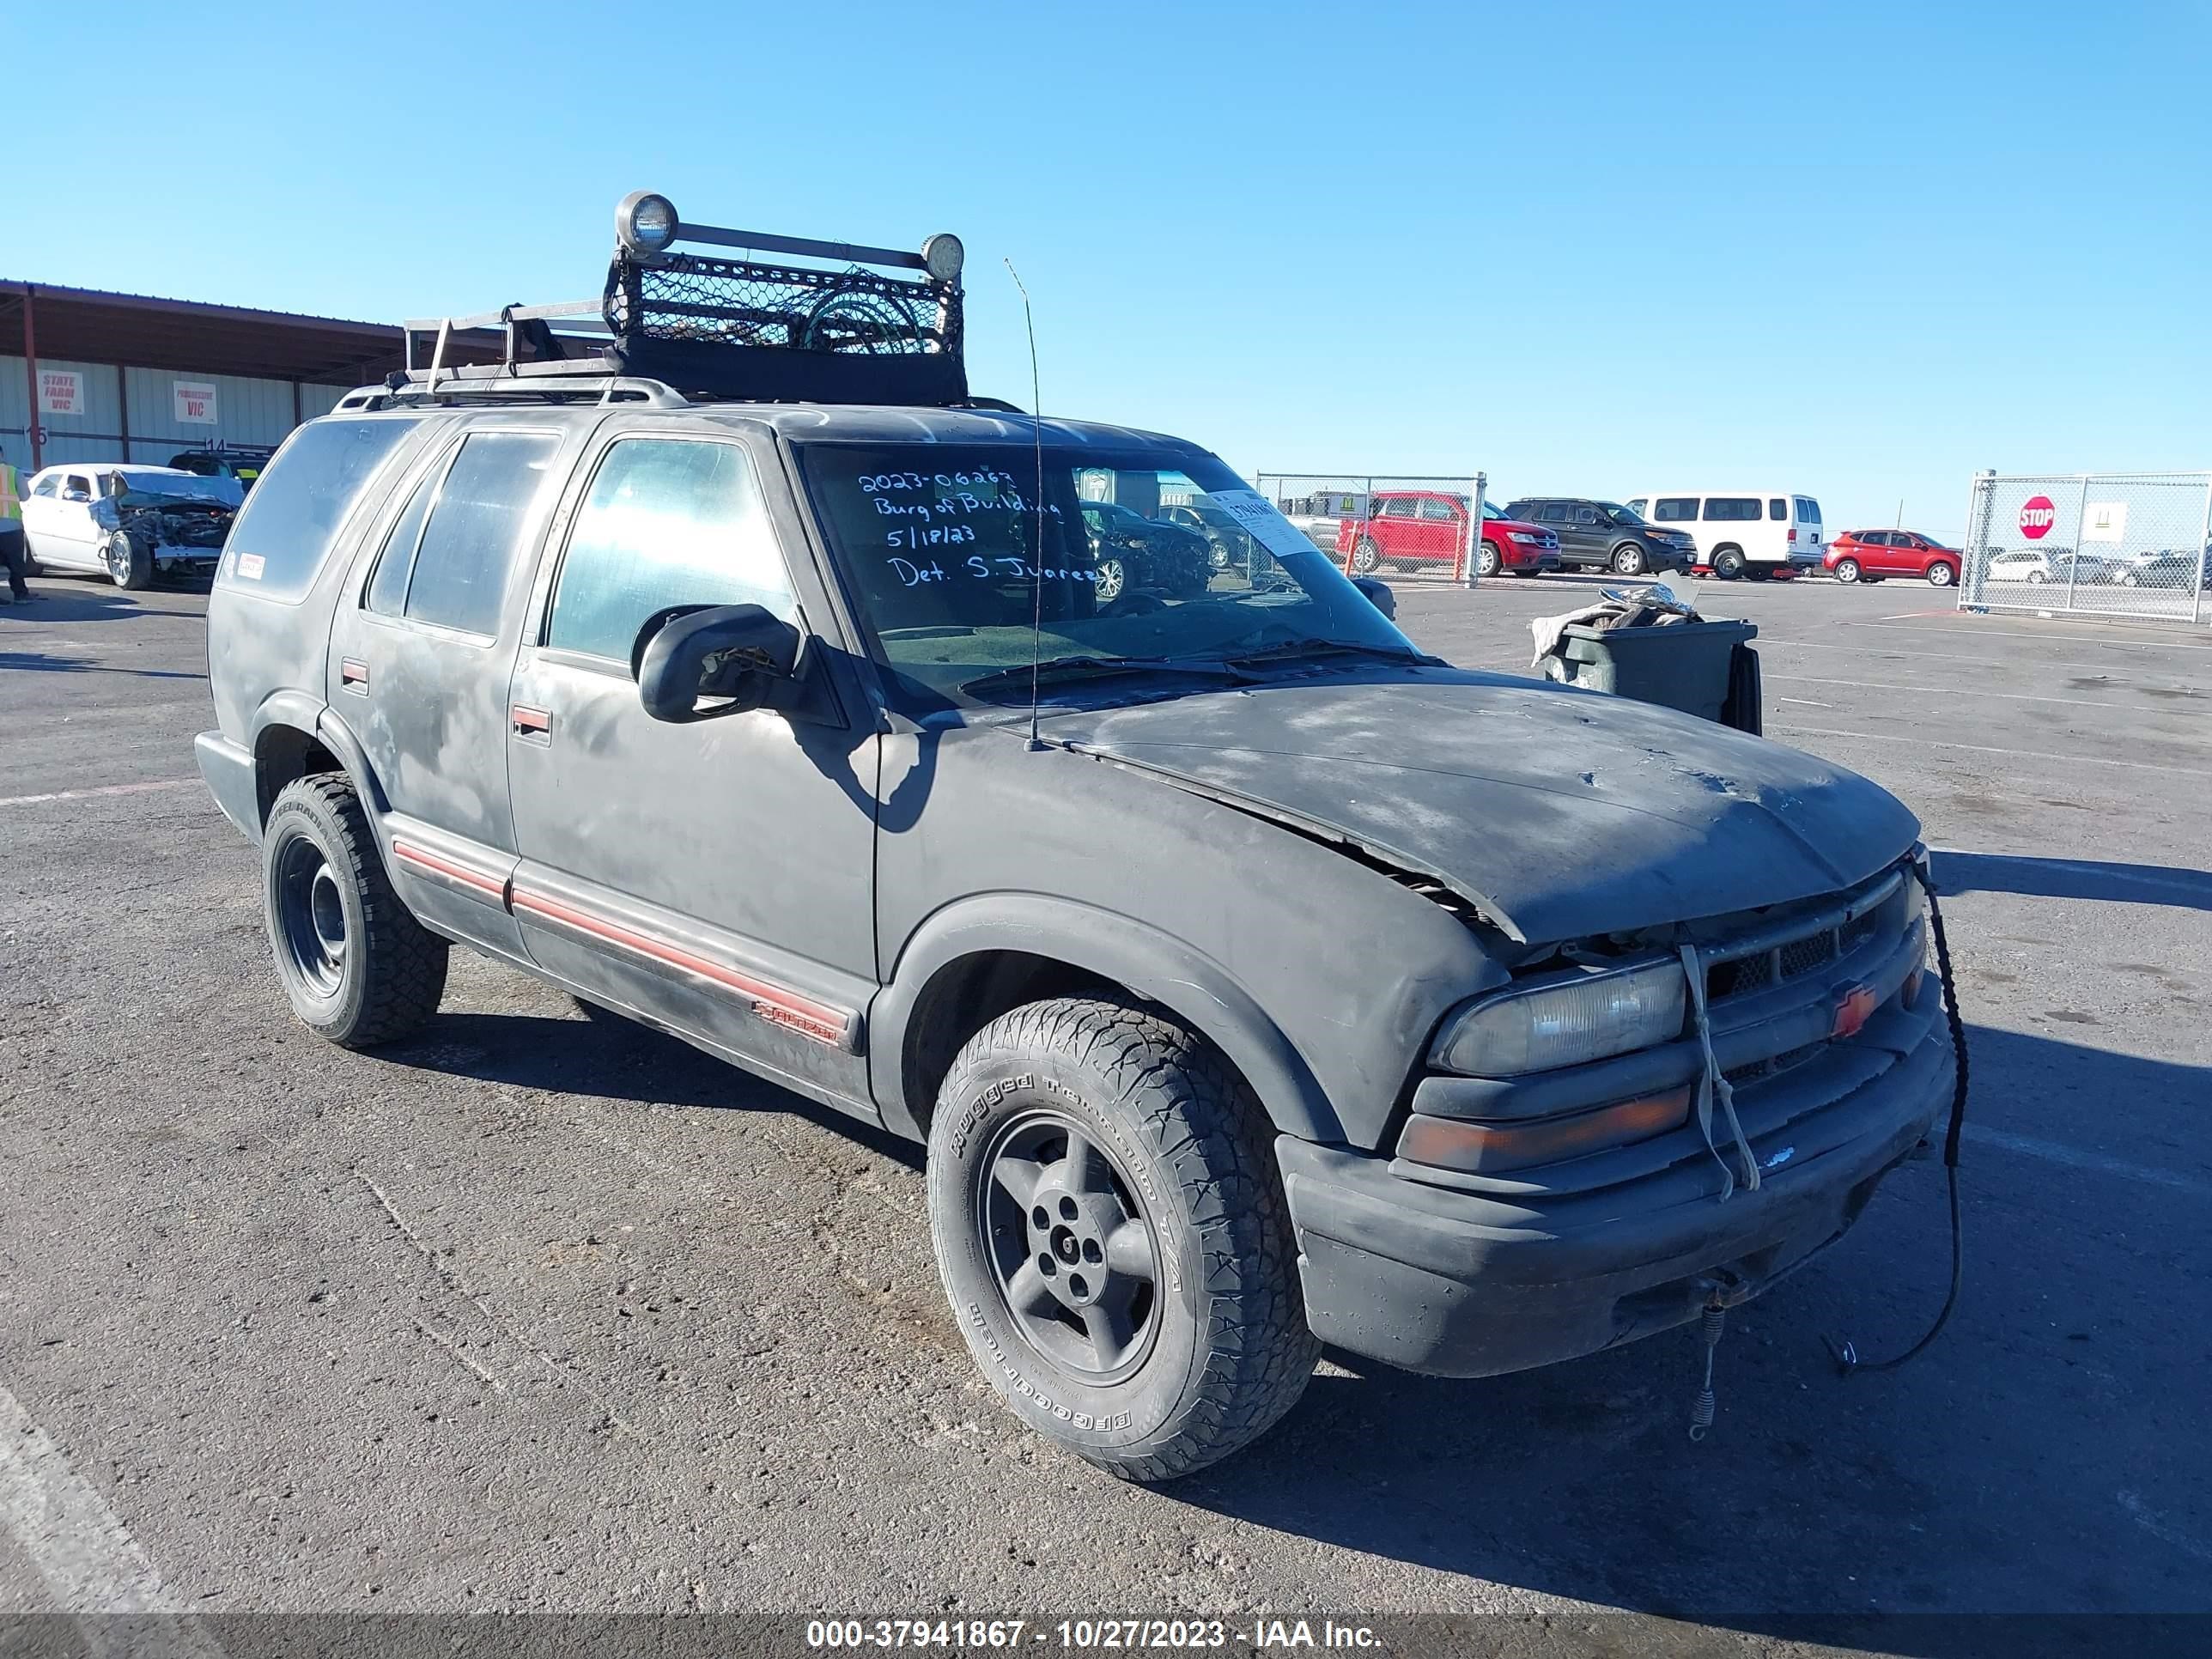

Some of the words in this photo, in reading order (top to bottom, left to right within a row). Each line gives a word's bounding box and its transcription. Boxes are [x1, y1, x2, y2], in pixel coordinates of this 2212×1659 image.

[43, 374, 76, 386] STATE
[44, 386, 75, 398] FARM
[52, 399, 70, 410] VIC
[187, 402, 204, 417] VIC
[872, 497, 930, 522] Burg
[934, 498, 957, 516] of
[956, 492, 1065, 525] Building
[2020, 507, 2054, 527] STOP
[887, 525, 975, 549] 5/18/23
[886, 557, 951, 586] Det.
[994, 557, 1096, 581] Juarez
[950, 1072, 1036, 1160] Rugged
[968, 1301, 1133, 1432] BFGoodrich
